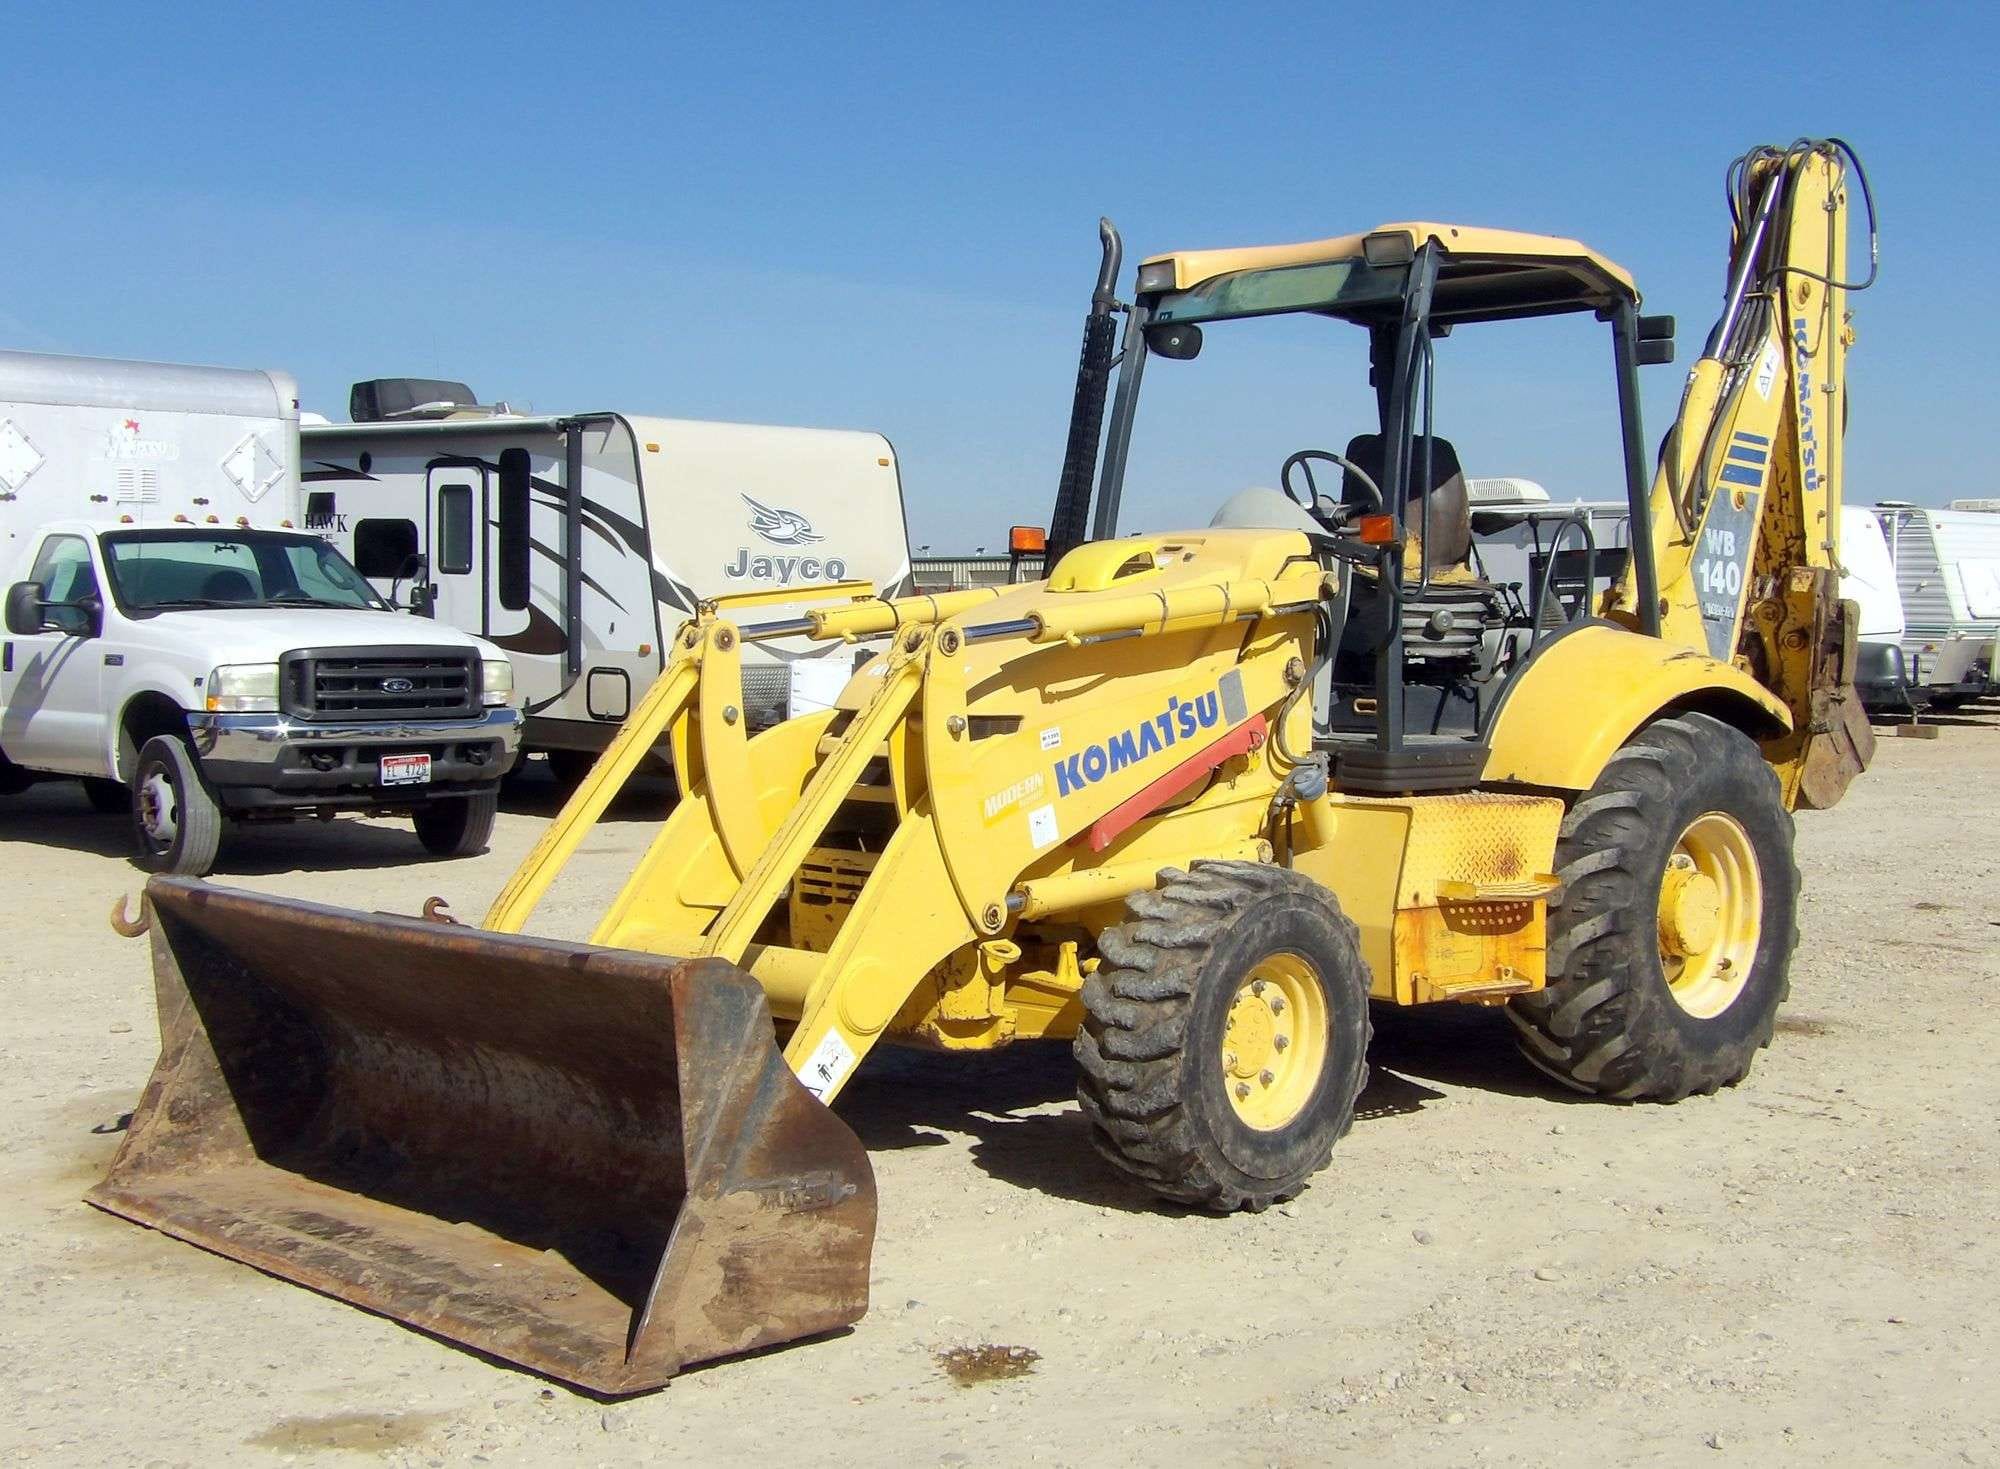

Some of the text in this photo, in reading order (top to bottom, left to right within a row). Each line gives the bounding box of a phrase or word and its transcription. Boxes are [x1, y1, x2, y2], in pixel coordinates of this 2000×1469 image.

[1794, 318, 1817, 491] KOMATSU
[304, 513, 348, 533] HAWK
[1705, 528, 1736, 557] WB
[725, 546, 847, 587] Jayco
[1699, 558, 1741, 596] 140
[1054, 690, 1219, 797] KOMATSU
[984, 773, 1044, 818] MODERN
